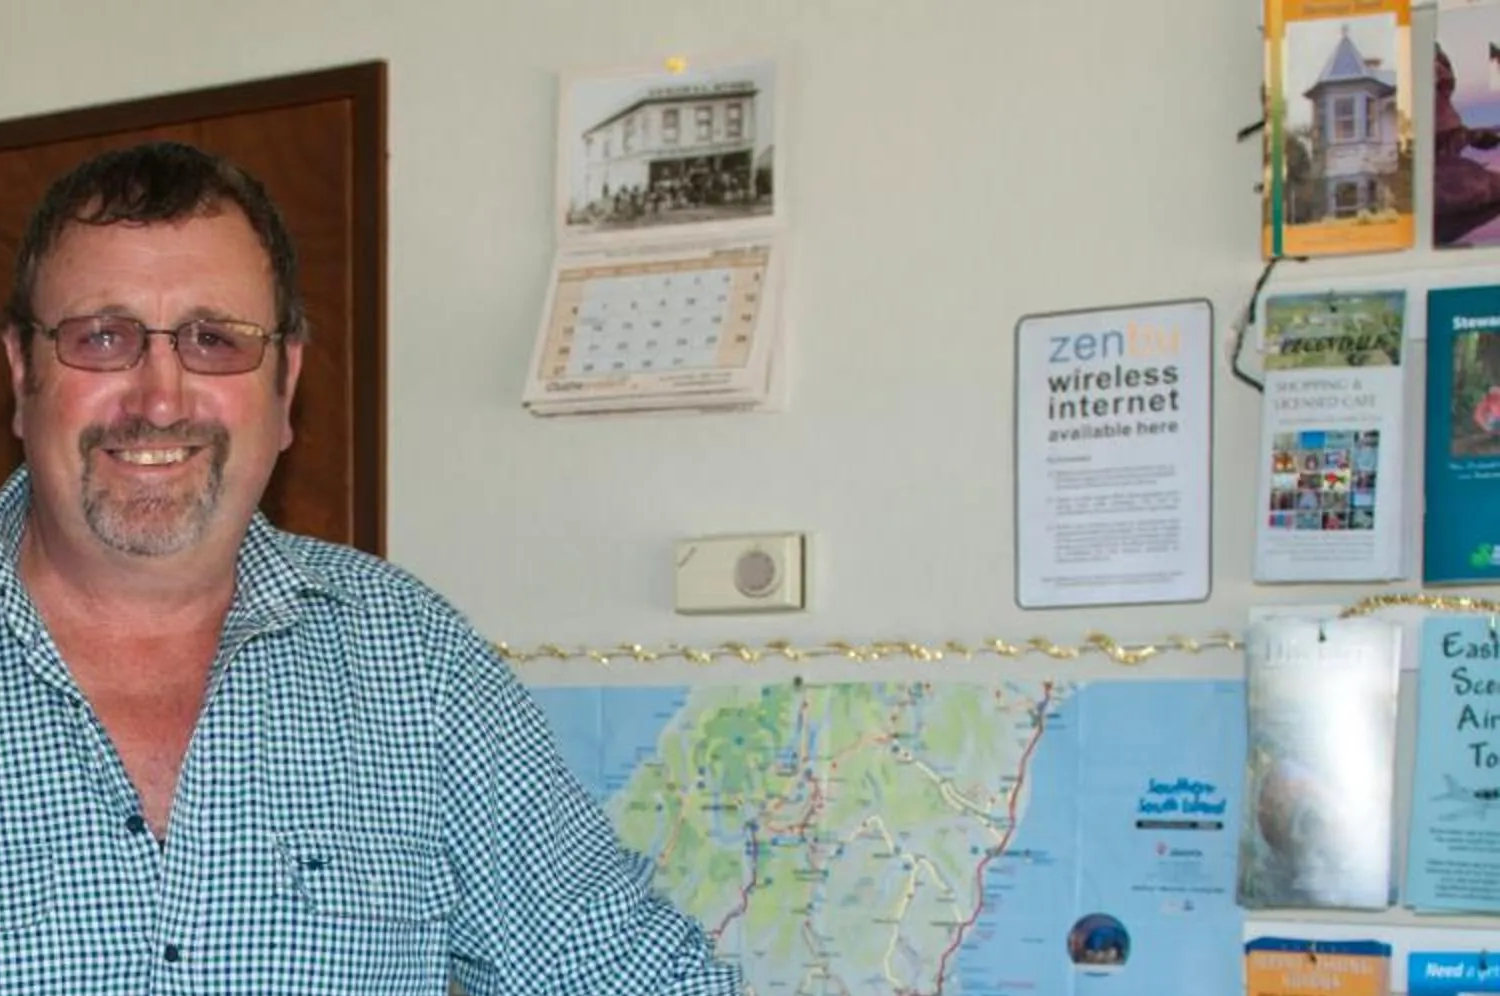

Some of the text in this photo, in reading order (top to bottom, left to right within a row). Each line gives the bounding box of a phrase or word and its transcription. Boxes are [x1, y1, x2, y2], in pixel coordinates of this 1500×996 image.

[1048, 364, 1179, 393] wireless
[1048, 388, 1179, 420] internet
[1048, 420, 1179, 442] available here
[1457, 703, 1500, 732] Air
[1468, 741, 1499, 769] To
[1425, 961, 1464, 979] Need
